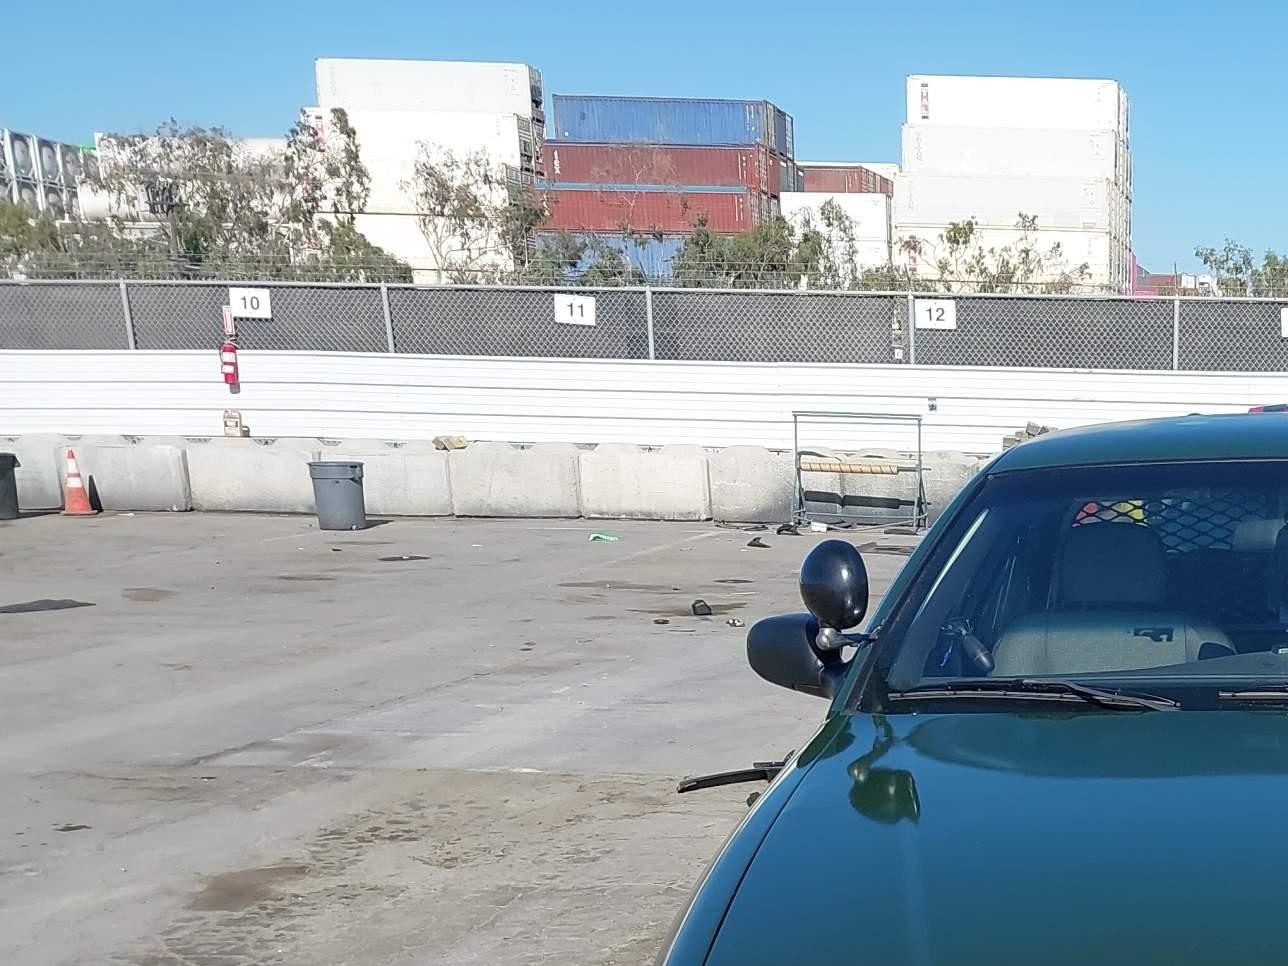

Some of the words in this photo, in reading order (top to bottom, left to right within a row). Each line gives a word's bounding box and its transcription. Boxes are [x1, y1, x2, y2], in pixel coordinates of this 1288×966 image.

[240, 295, 260, 311] 10
[567, 302, 584, 318] 11
[925, 307, 945, 322] 12
